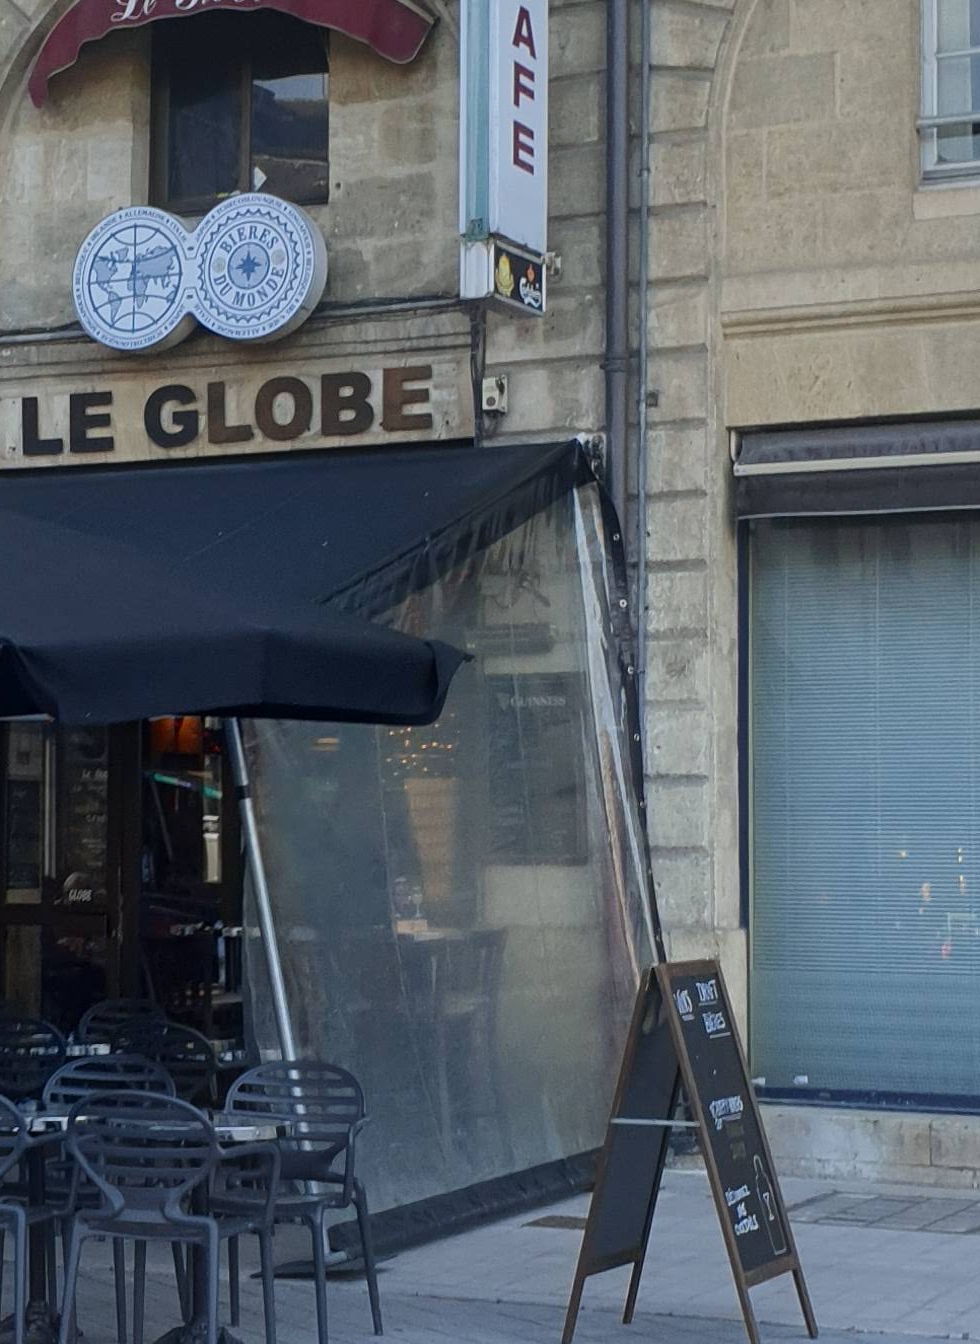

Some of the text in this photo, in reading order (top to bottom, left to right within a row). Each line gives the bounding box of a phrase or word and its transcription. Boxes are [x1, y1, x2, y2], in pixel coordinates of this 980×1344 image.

[219, 225, 280, 255] BIERES
[213, 266, 285, 308] DU MONDE
[21, 365, 434, 456] LE GLOBE
